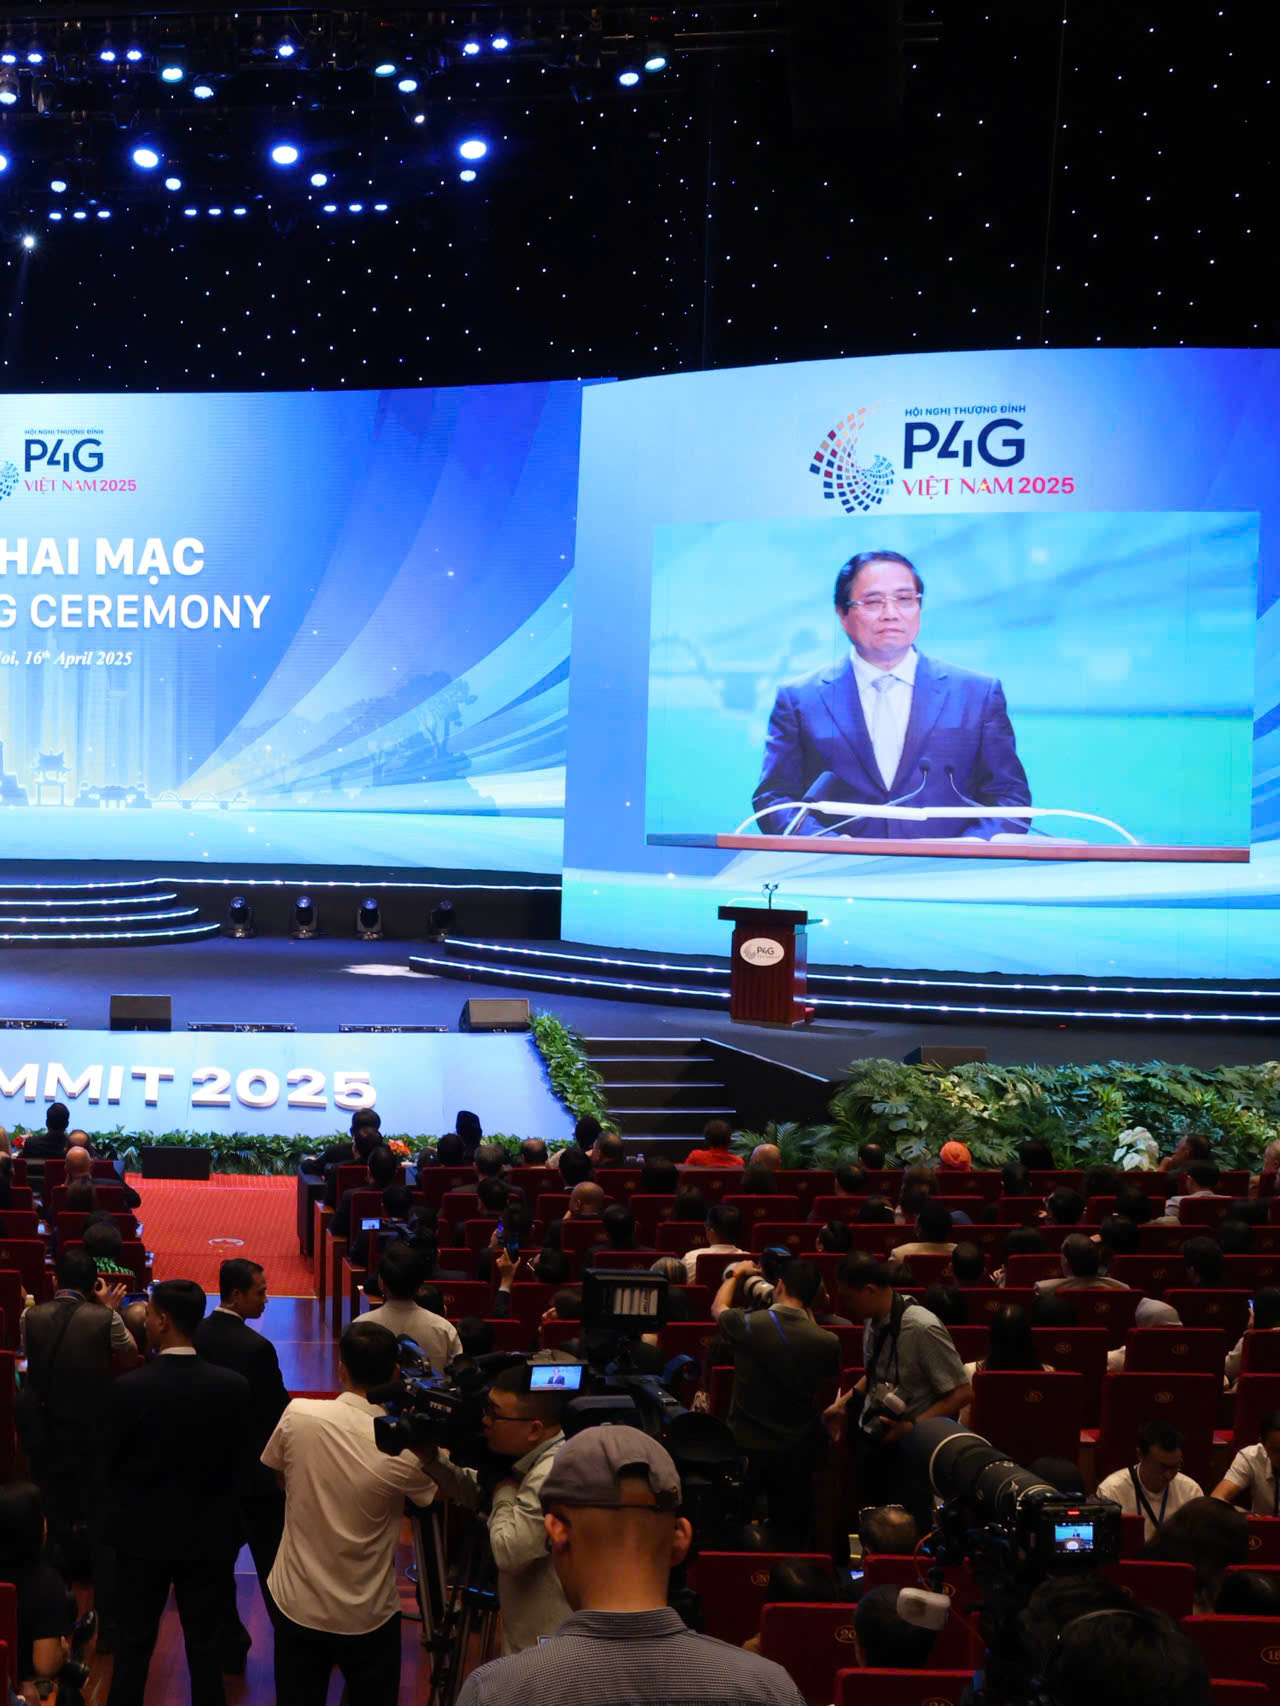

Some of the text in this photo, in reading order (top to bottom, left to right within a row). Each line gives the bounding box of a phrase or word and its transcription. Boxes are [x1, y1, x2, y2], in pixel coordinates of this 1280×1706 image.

[905, 406, 923, 417] HỘI
[25, 438, 104, 472] P4G
[904, 418, 1026, 469] P4G
[62, 480, 97, 491] NAM
[100, 479, 137, 491] 2025
[902, 475, 1075, 499] VIỆT NAM 2025
[96, 537, 205, 585] MẠC
[30, 594, 271, 629] CEREMONY
[53, 651, 92, 669] April
[95, 651, 132, 666] 2025
[192, 1067, 377, 1111] 2025
